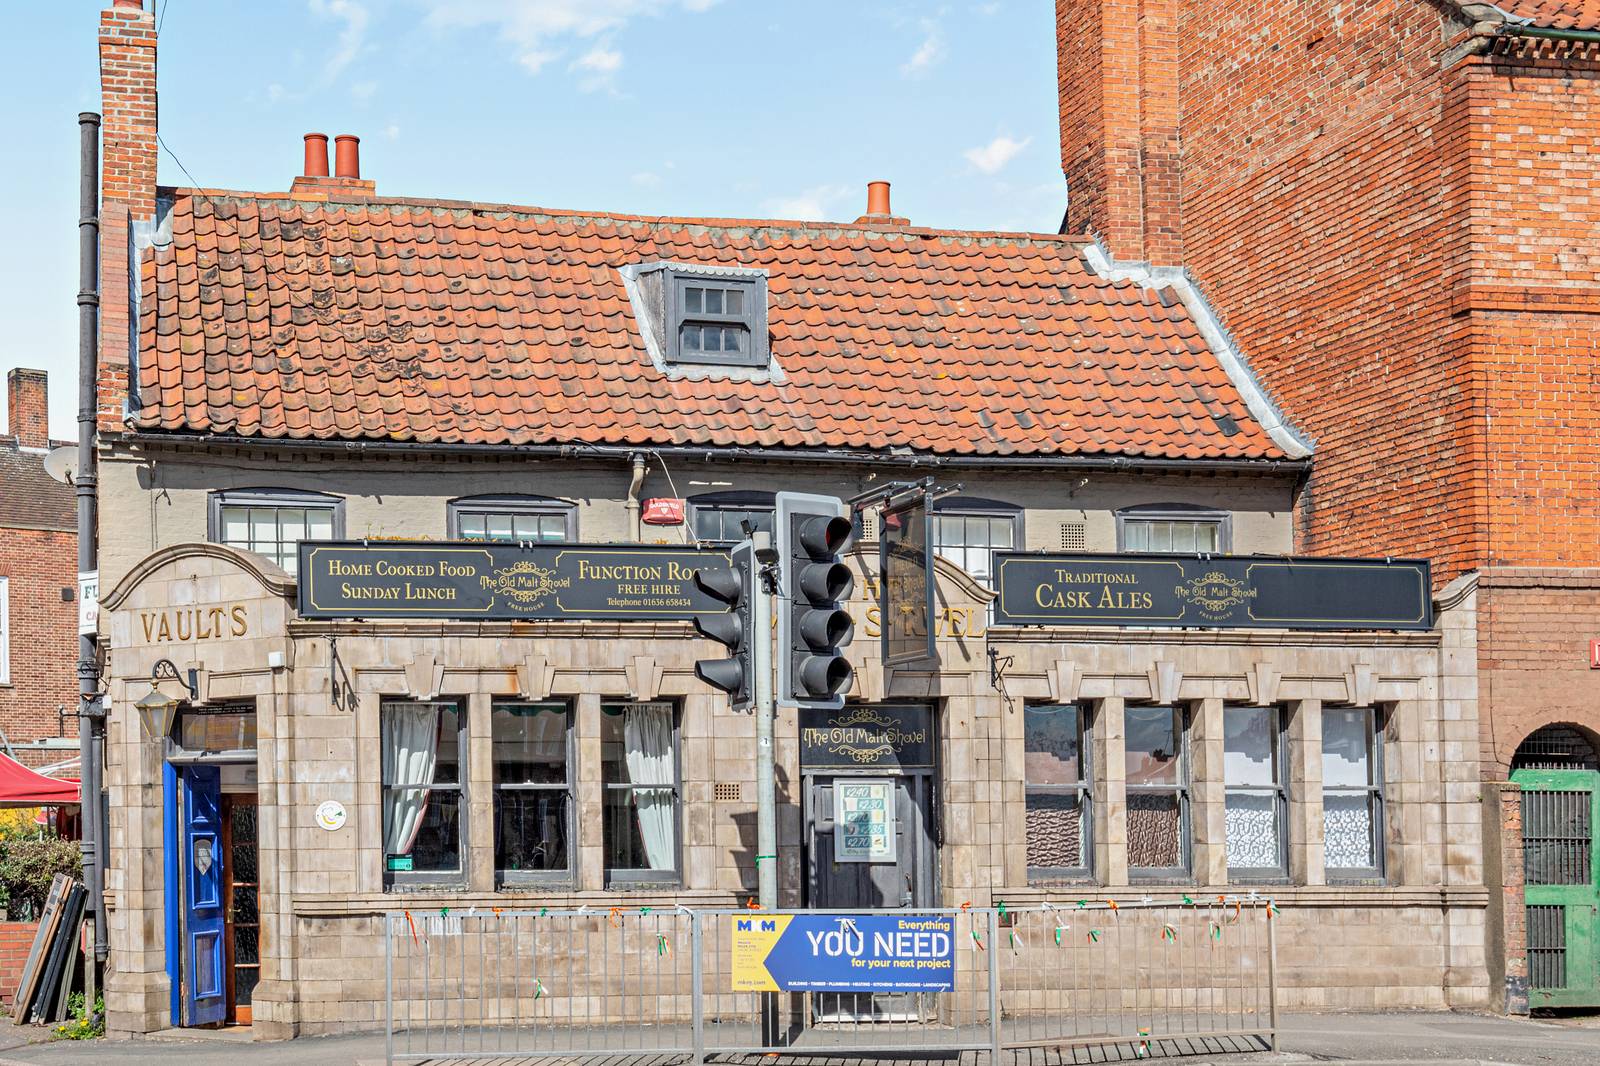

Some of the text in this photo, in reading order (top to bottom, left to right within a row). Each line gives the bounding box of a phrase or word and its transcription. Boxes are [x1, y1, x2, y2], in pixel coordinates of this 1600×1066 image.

[328, 560, 476, 577] HOME COOKED FOOD
[578, 560, 718, 581] FUNCTION RO
[1055, 569, 1138, 584] TRADITIONAL
[480, 575, 570, 590] The Old Malt Shovel
[617, 584, 681, 595] FREE HIRE
[341, 582, 456, 600] SUNDAY LUNCH
[1035, 583, 1153, 609] CASK ALES
[1175, 586, 1257, 599] The Old Malt Shovel
[607, 597, 691, 607] Telephone 01636 658434
[141, 605, 248, 643] VAULTS
[803, 727, 828, 748] The
[830, 727, 854, 744] Old
[885, 728, 926, 746] Shovel
[898, 919, 950, 931] Everything
[806, 930, 950, 958] YOU NEED
[851, 958, 951, 970] for your next project
